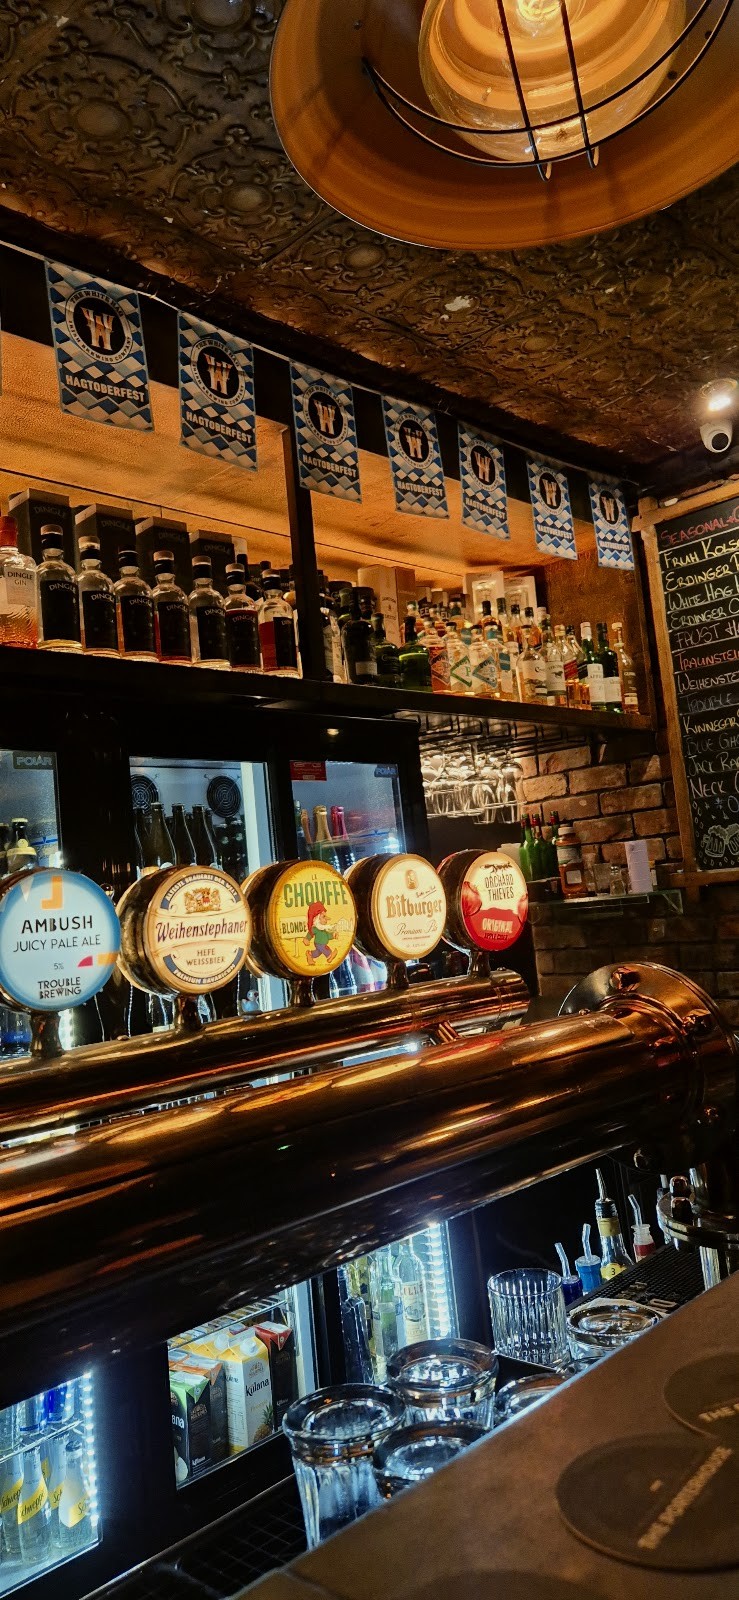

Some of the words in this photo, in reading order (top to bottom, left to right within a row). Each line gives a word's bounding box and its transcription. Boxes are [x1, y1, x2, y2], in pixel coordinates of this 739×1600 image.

[65, 374, 145, 403] HAGTOBERFEST
[185, 411, 253, 443] HAGTOBERFEST
[302, 454, 357, 478] HAGTOBERFEST
[7, 571, 34, 581] DINGLE
[666, 563, 731, 592] ERDINGER
[668, 592, 706, 612] WHITE
[705, 583, 734, 602] HAG
[670, 606, 727, 631] ERDINGER
[677, 671, 739, 694] WEIHENSTE
[690, 777, 727, 799] NECK
[484, 873, 514, 889] ORCHARD
[283, 880, 348, 908] CHOUFFE
[488, 886, 515, 901] THIEVES
[385, 894, 442, 918] Bitburger
[21, 915, 94, 934] AMBUSH
[155, 918, 249, 943] Weihenstephaner
[281, 921, 307, 935] BLONDE
[13, 939, 47, 952] JUICY
[51, 937, 79, 949] PALE
[81, 934, 101, 947] ALE
[197, 948, 216, 957] HEFE
[53, 962, 64, 970] 5%
[186, 956, 226, 967] WEISSBIER
[38, 976, 81, 990] TROUBLE
[39, 986, 82, 1000] BREWING
[611, 1267, 617, 1276] 3
[246, 1378, 270, 1397] kulana
